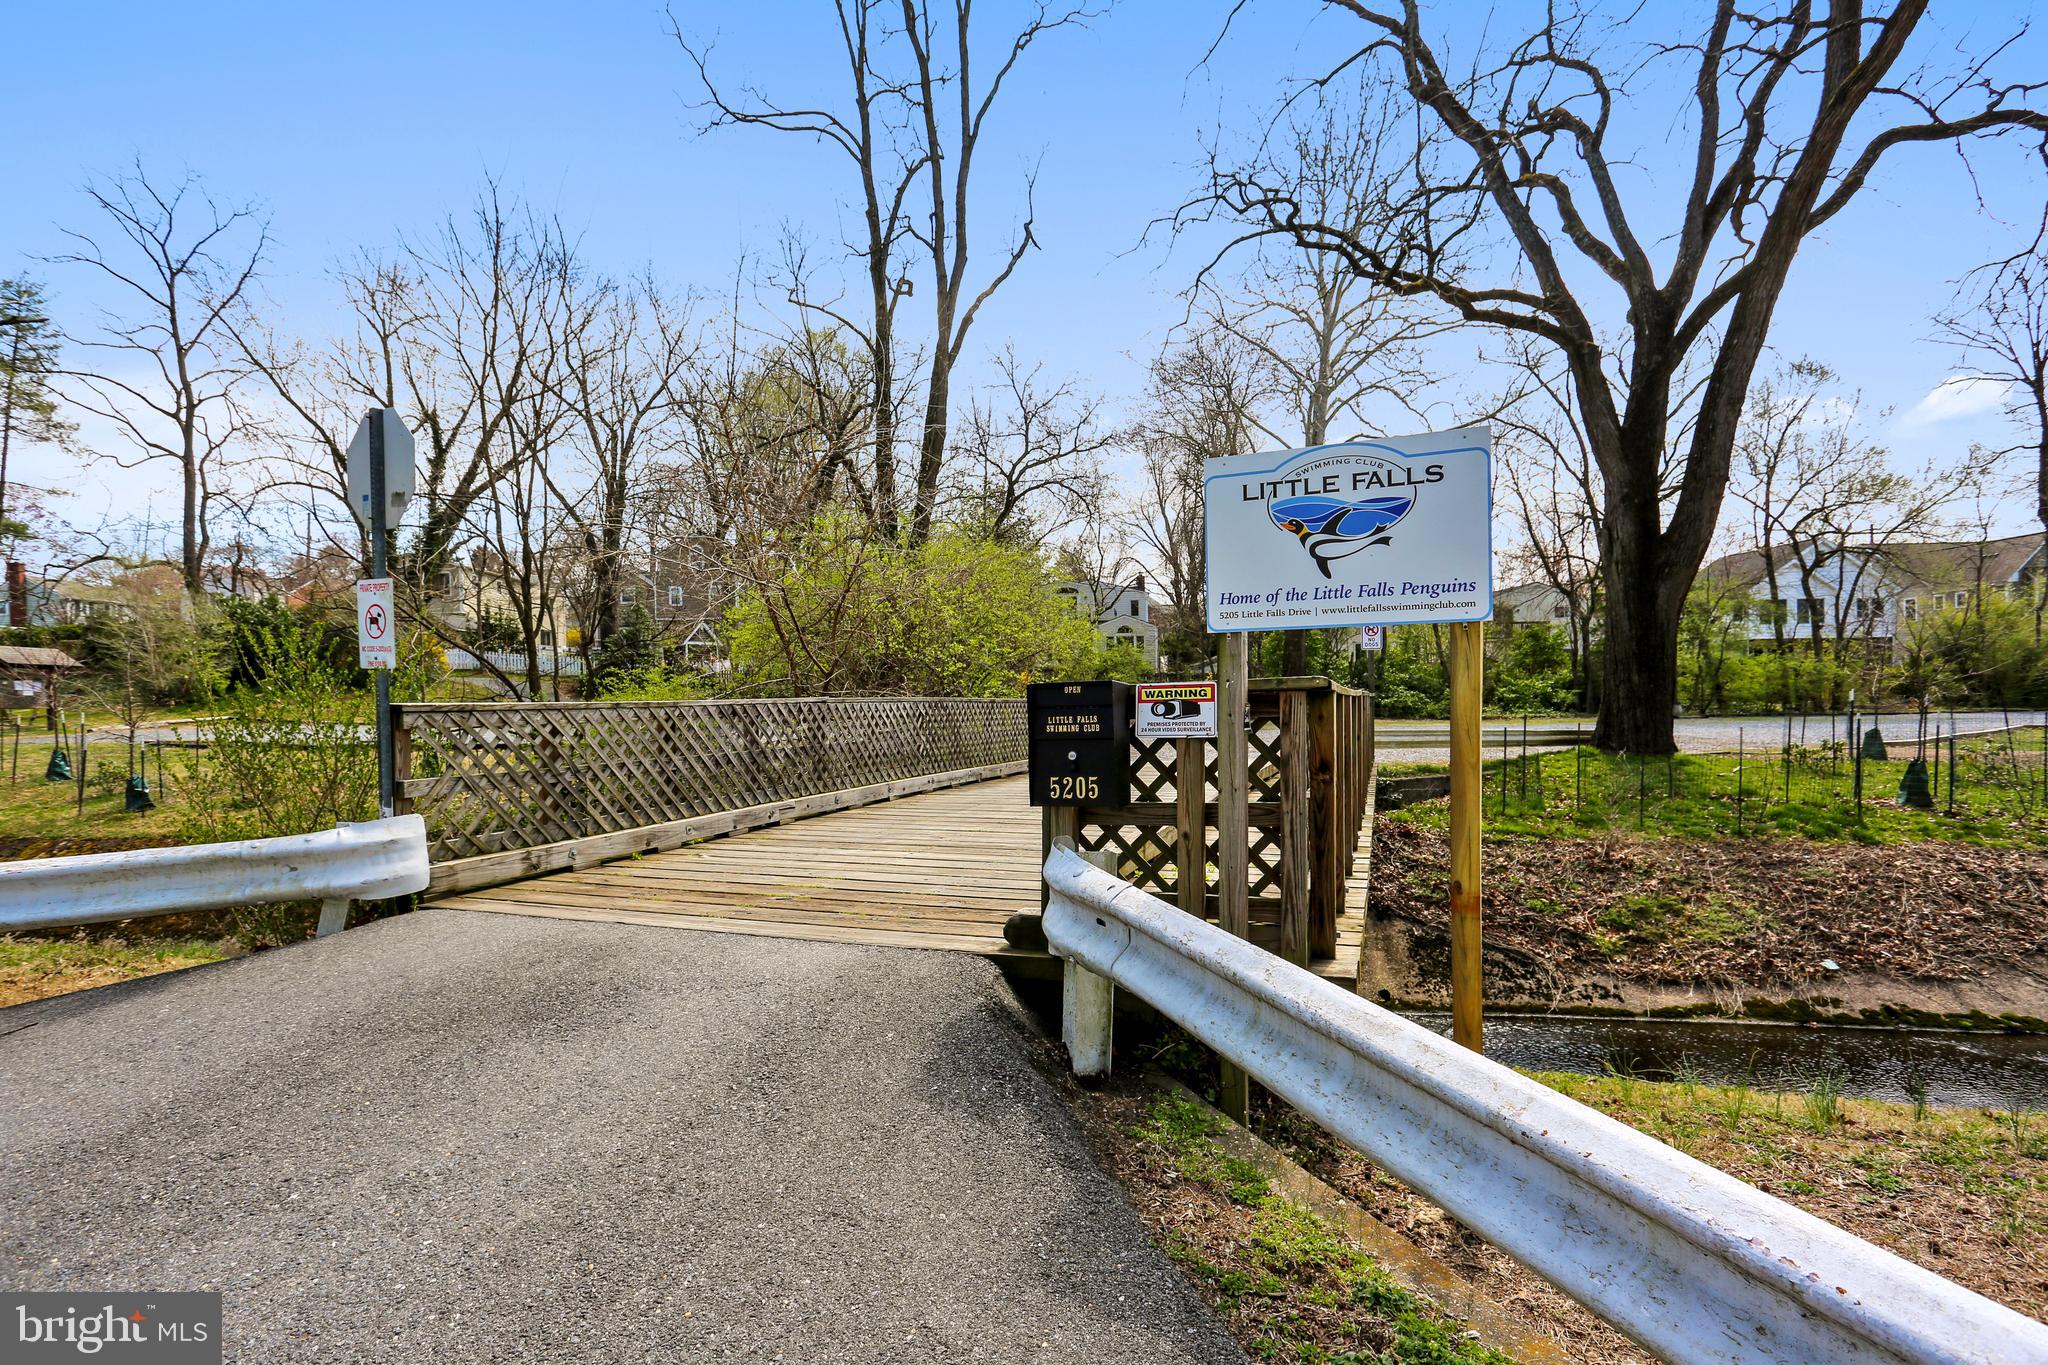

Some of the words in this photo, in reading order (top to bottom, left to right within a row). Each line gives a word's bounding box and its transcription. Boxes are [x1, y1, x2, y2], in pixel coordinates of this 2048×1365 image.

[1295, 458, 1351, 478] SWIMMING
[1355, 458, 1385, 469] CLUB
[1242, 474, 1340, 501] LITTLE
[1352, 464, 1445, 490] FALLS
[1219, 592, 1261, 605] Home
[1265, 588, 1283, 606] of
[1285, 587, 1308, 602] the
[1313, 584, 1352, 600] Little
[1357, 582, 1395, 598] Falls
[1400, 578, 1477, 599] Penguins
[1219, 611, 1239, 620] 5205
[1241, 609, 1264, 618] Little
[1266, 608, 1286, 617] Falls
[1288, 607, 1312, 616] Drive
[1321, 600, 1476, 615] www.littlefallsswimmingclub.com
[1064, 685, 1082, 694] OPEN
[1144, 688, 1208, 699] WARNING
[1046, 724, 1080, 733] SWIMMING
[1083, 724, 1101, 732] CLUB
[1048, 716, 1073, 724] LITTLE
[1077, 715, 1098, 723] FALLS
[1049, 776, 1099, 799] 5205
